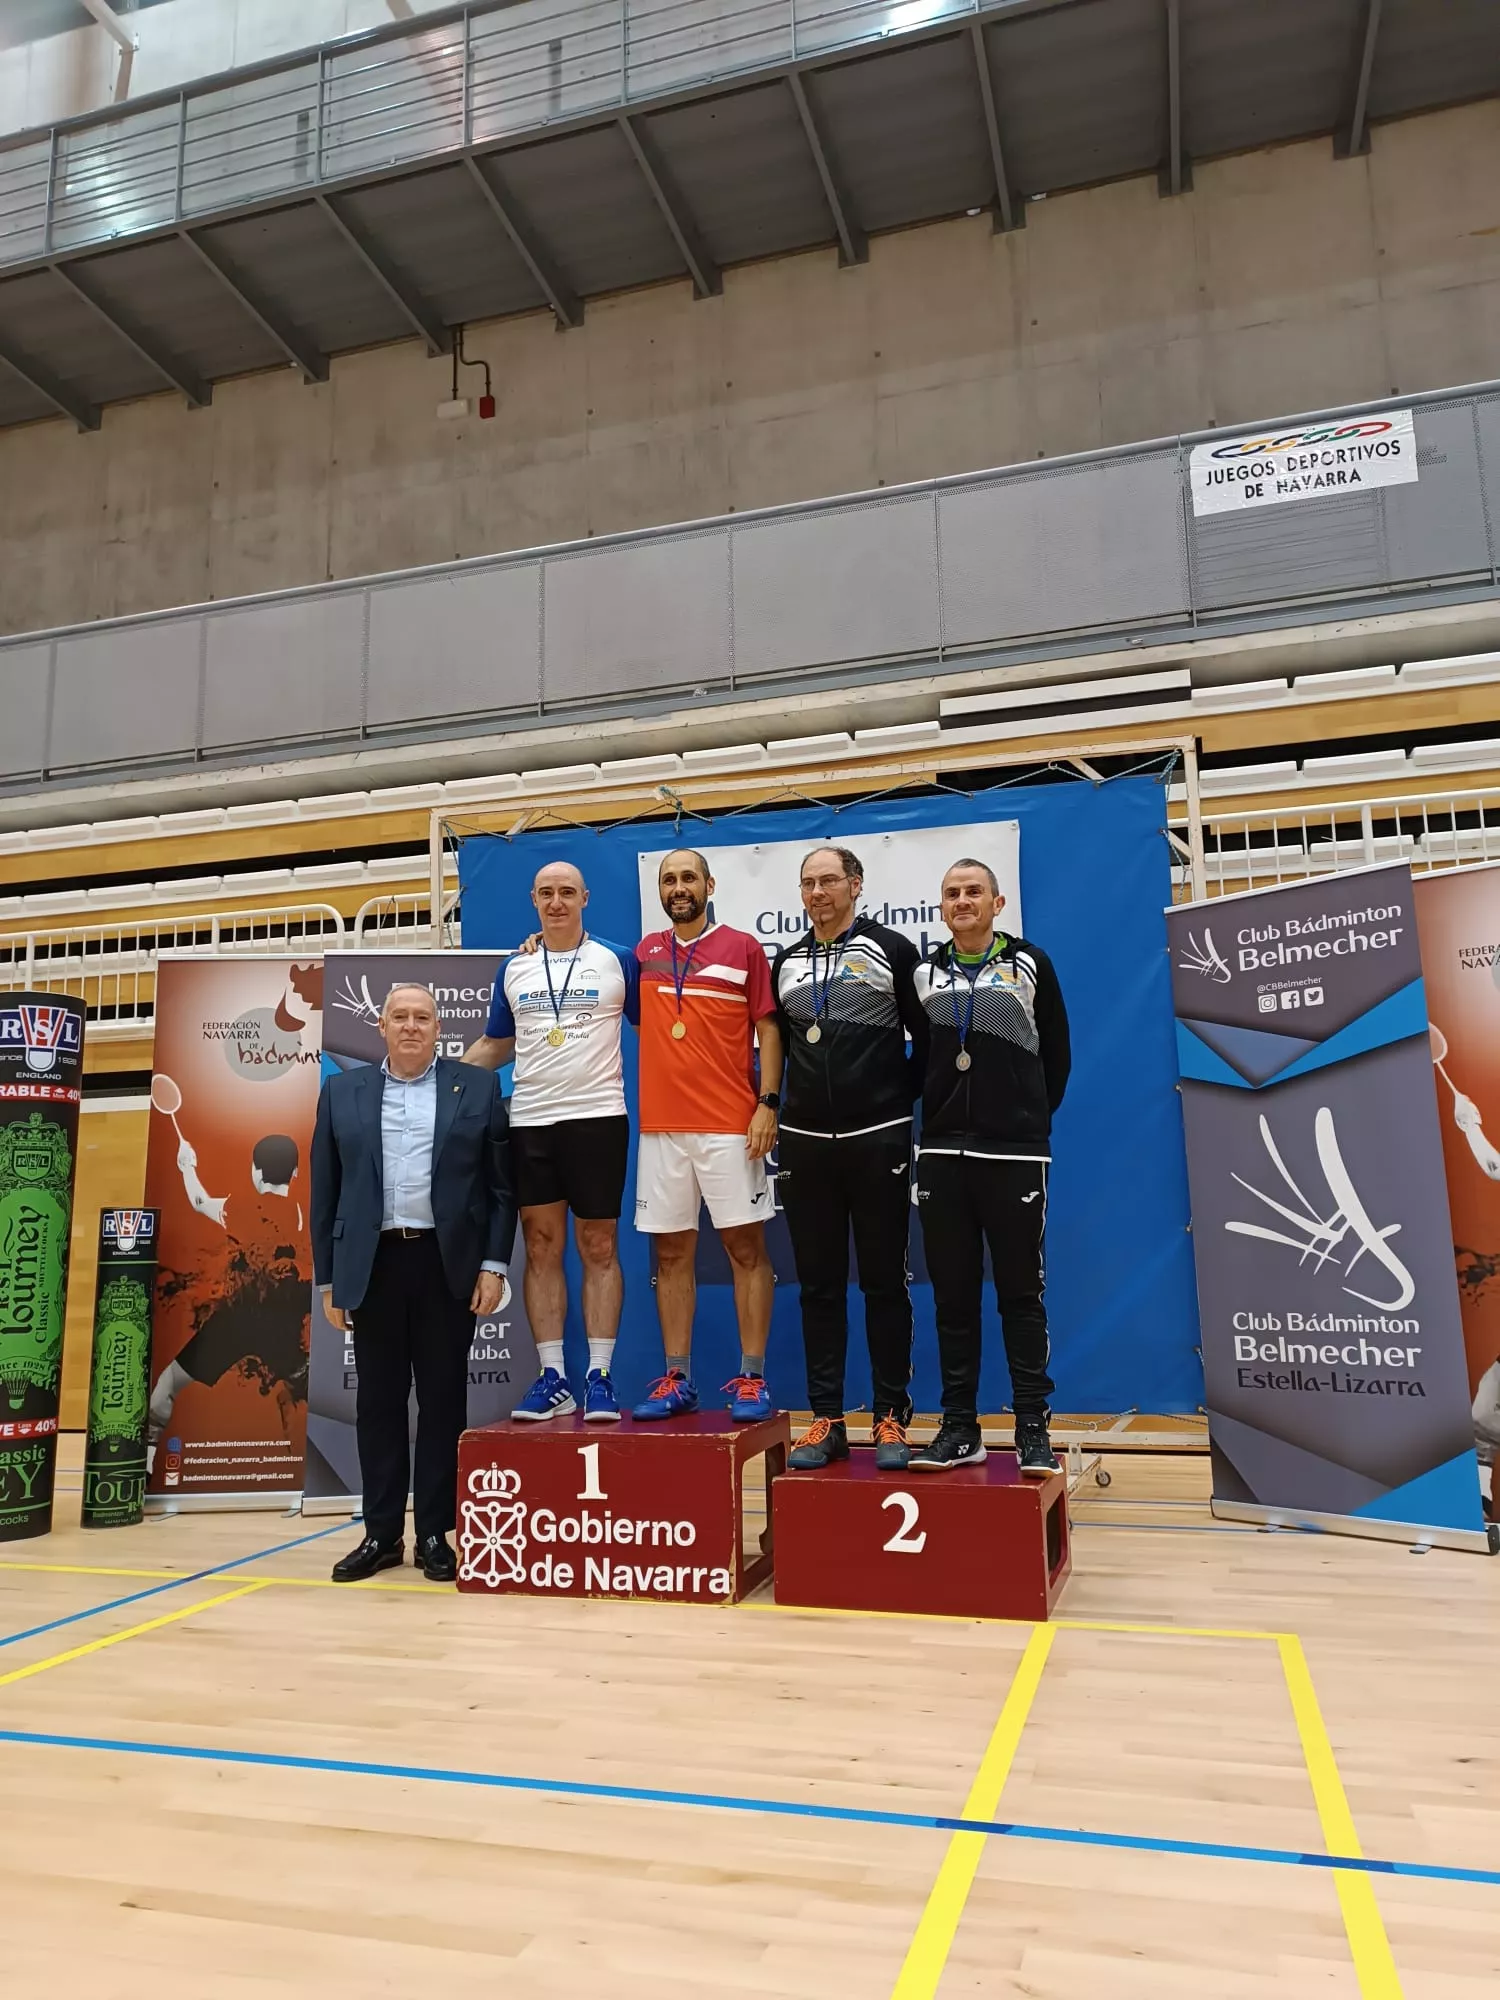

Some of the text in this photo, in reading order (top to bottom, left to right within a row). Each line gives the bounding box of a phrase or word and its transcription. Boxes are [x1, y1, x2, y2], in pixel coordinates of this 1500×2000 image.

[1206, 439, 1401, 486] JUEGOS DEPORTIVOS
[1244, 469, 1362, 499] DE NAVARRA
[1237, 905, 1402, 945] Club Bádminton
[1238, 928, 1404, 972] Belmecher
[1459, 944, 1500, 958] FEDERA
[1461, 954, 1500, 970] NAVA
[1257, 976, 1323, 993] @CBBelmecher
[1, 1018, 78, 1044] RSL
[202, 1020, 261, 1030] FEDERACIÓN
[202, 1030, 260, 1040] NAVARRA
[237, 1041, 322, 1064] bádmint
[16, 1072, 62, 1081] ENGLAND
[0, 1085, 51, 1098] RABLE
[105, 1219, 151, 1232] RSL
[34, 1292, 50, 1344] Classic
[1232, 1312, 1420, 1334] Club Bádminton
[1234, 1335, 1422, 1367] Belmecher
[101, 1331, 133, 1414] Tourney
[1237, 1368, 1426, 1397] Estella-Lizarra
[35, 1419, 57, 1433] 40%
[184, 1439, 291, 1448] www.badmintonnavarra.com
[0, 1444, 46, 1466] assic
[183, 1455, 303, 1465] @federacion_navarra_badminton
[182, 1472, 294, 1482] badmintonnavarra@gmail.com
[576, 1442, 608, 1500] 1
[0, 1513, 29, 1526] cocks
[530, 1508, 696, 1547] Gobierno
[881, 1491, 926, 1553] 2
[530, 1554, 730, 1594] de Navarra
